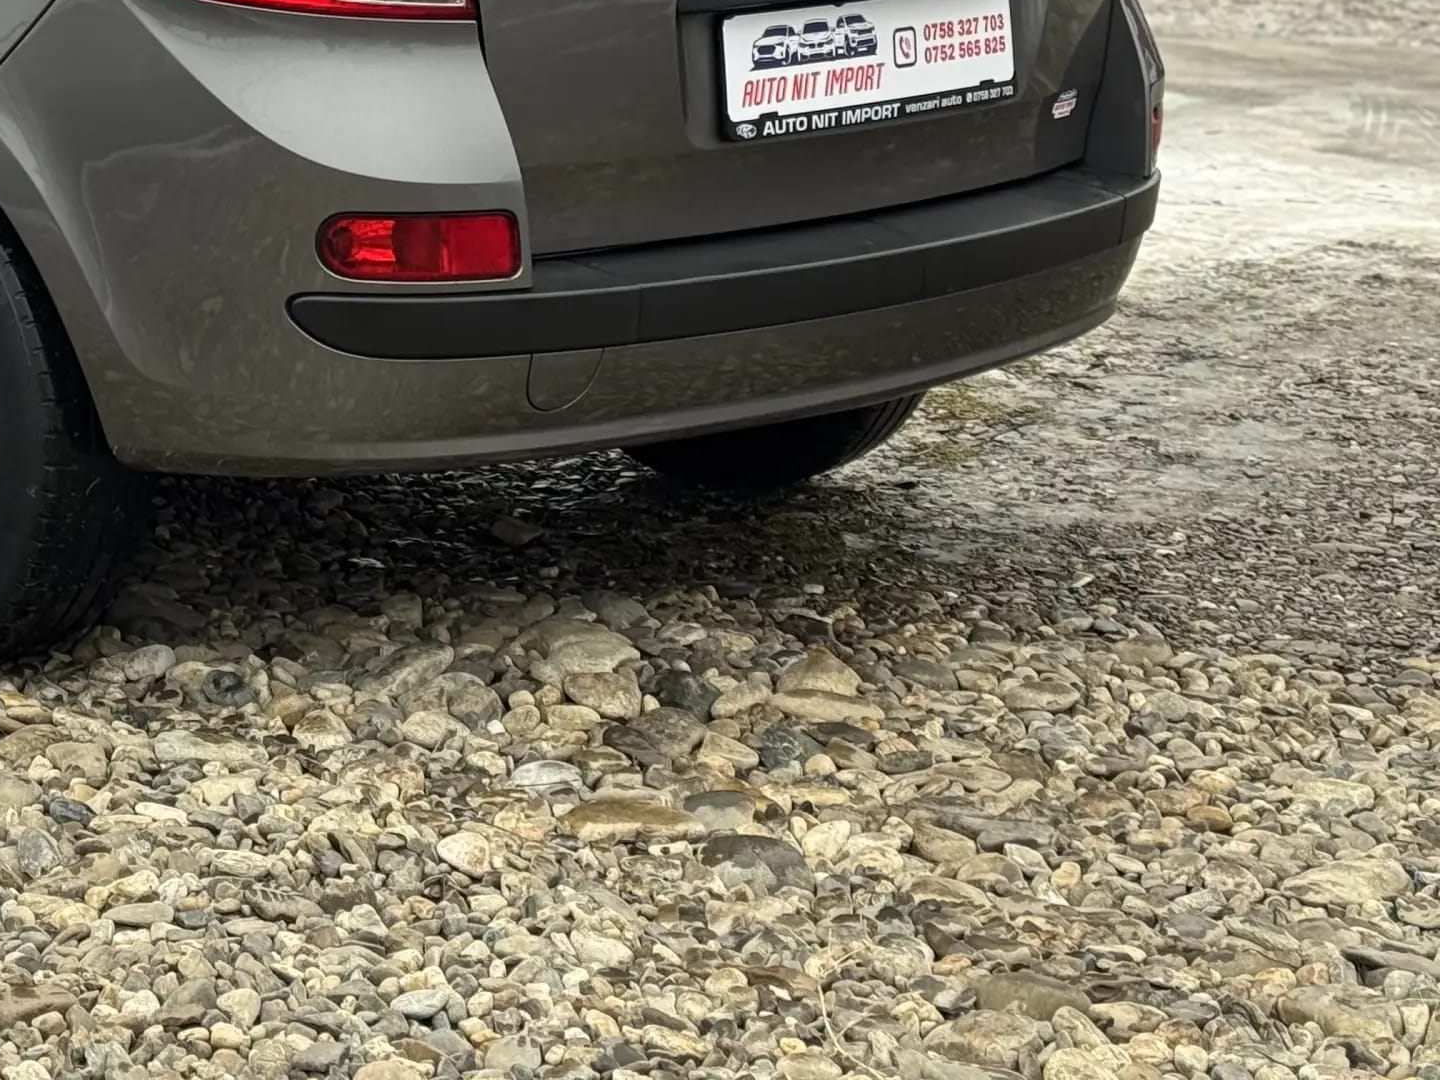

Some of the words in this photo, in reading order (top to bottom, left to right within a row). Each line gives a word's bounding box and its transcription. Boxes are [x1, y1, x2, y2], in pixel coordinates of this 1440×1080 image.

[923, 21, 954, 41] 0758
[957, 17, 979, 36] 327
[982, 13, 1004, 33] 703
[924, 44, 956, 64] 0752
[958, 40, 982, 59] 565
[984, 36, 1006, 55] 825
[742, 76, 788, 108] AUTO
[791, 71, 821, 101] NIT
[824, 63, 886, 97] IMPORT
[763, 116, 808, 136] AUTO
[812, 112, 839, 130] NIT
[842, 103, 901, 126] IMPORT
[941, 94, 963, 107] auto
